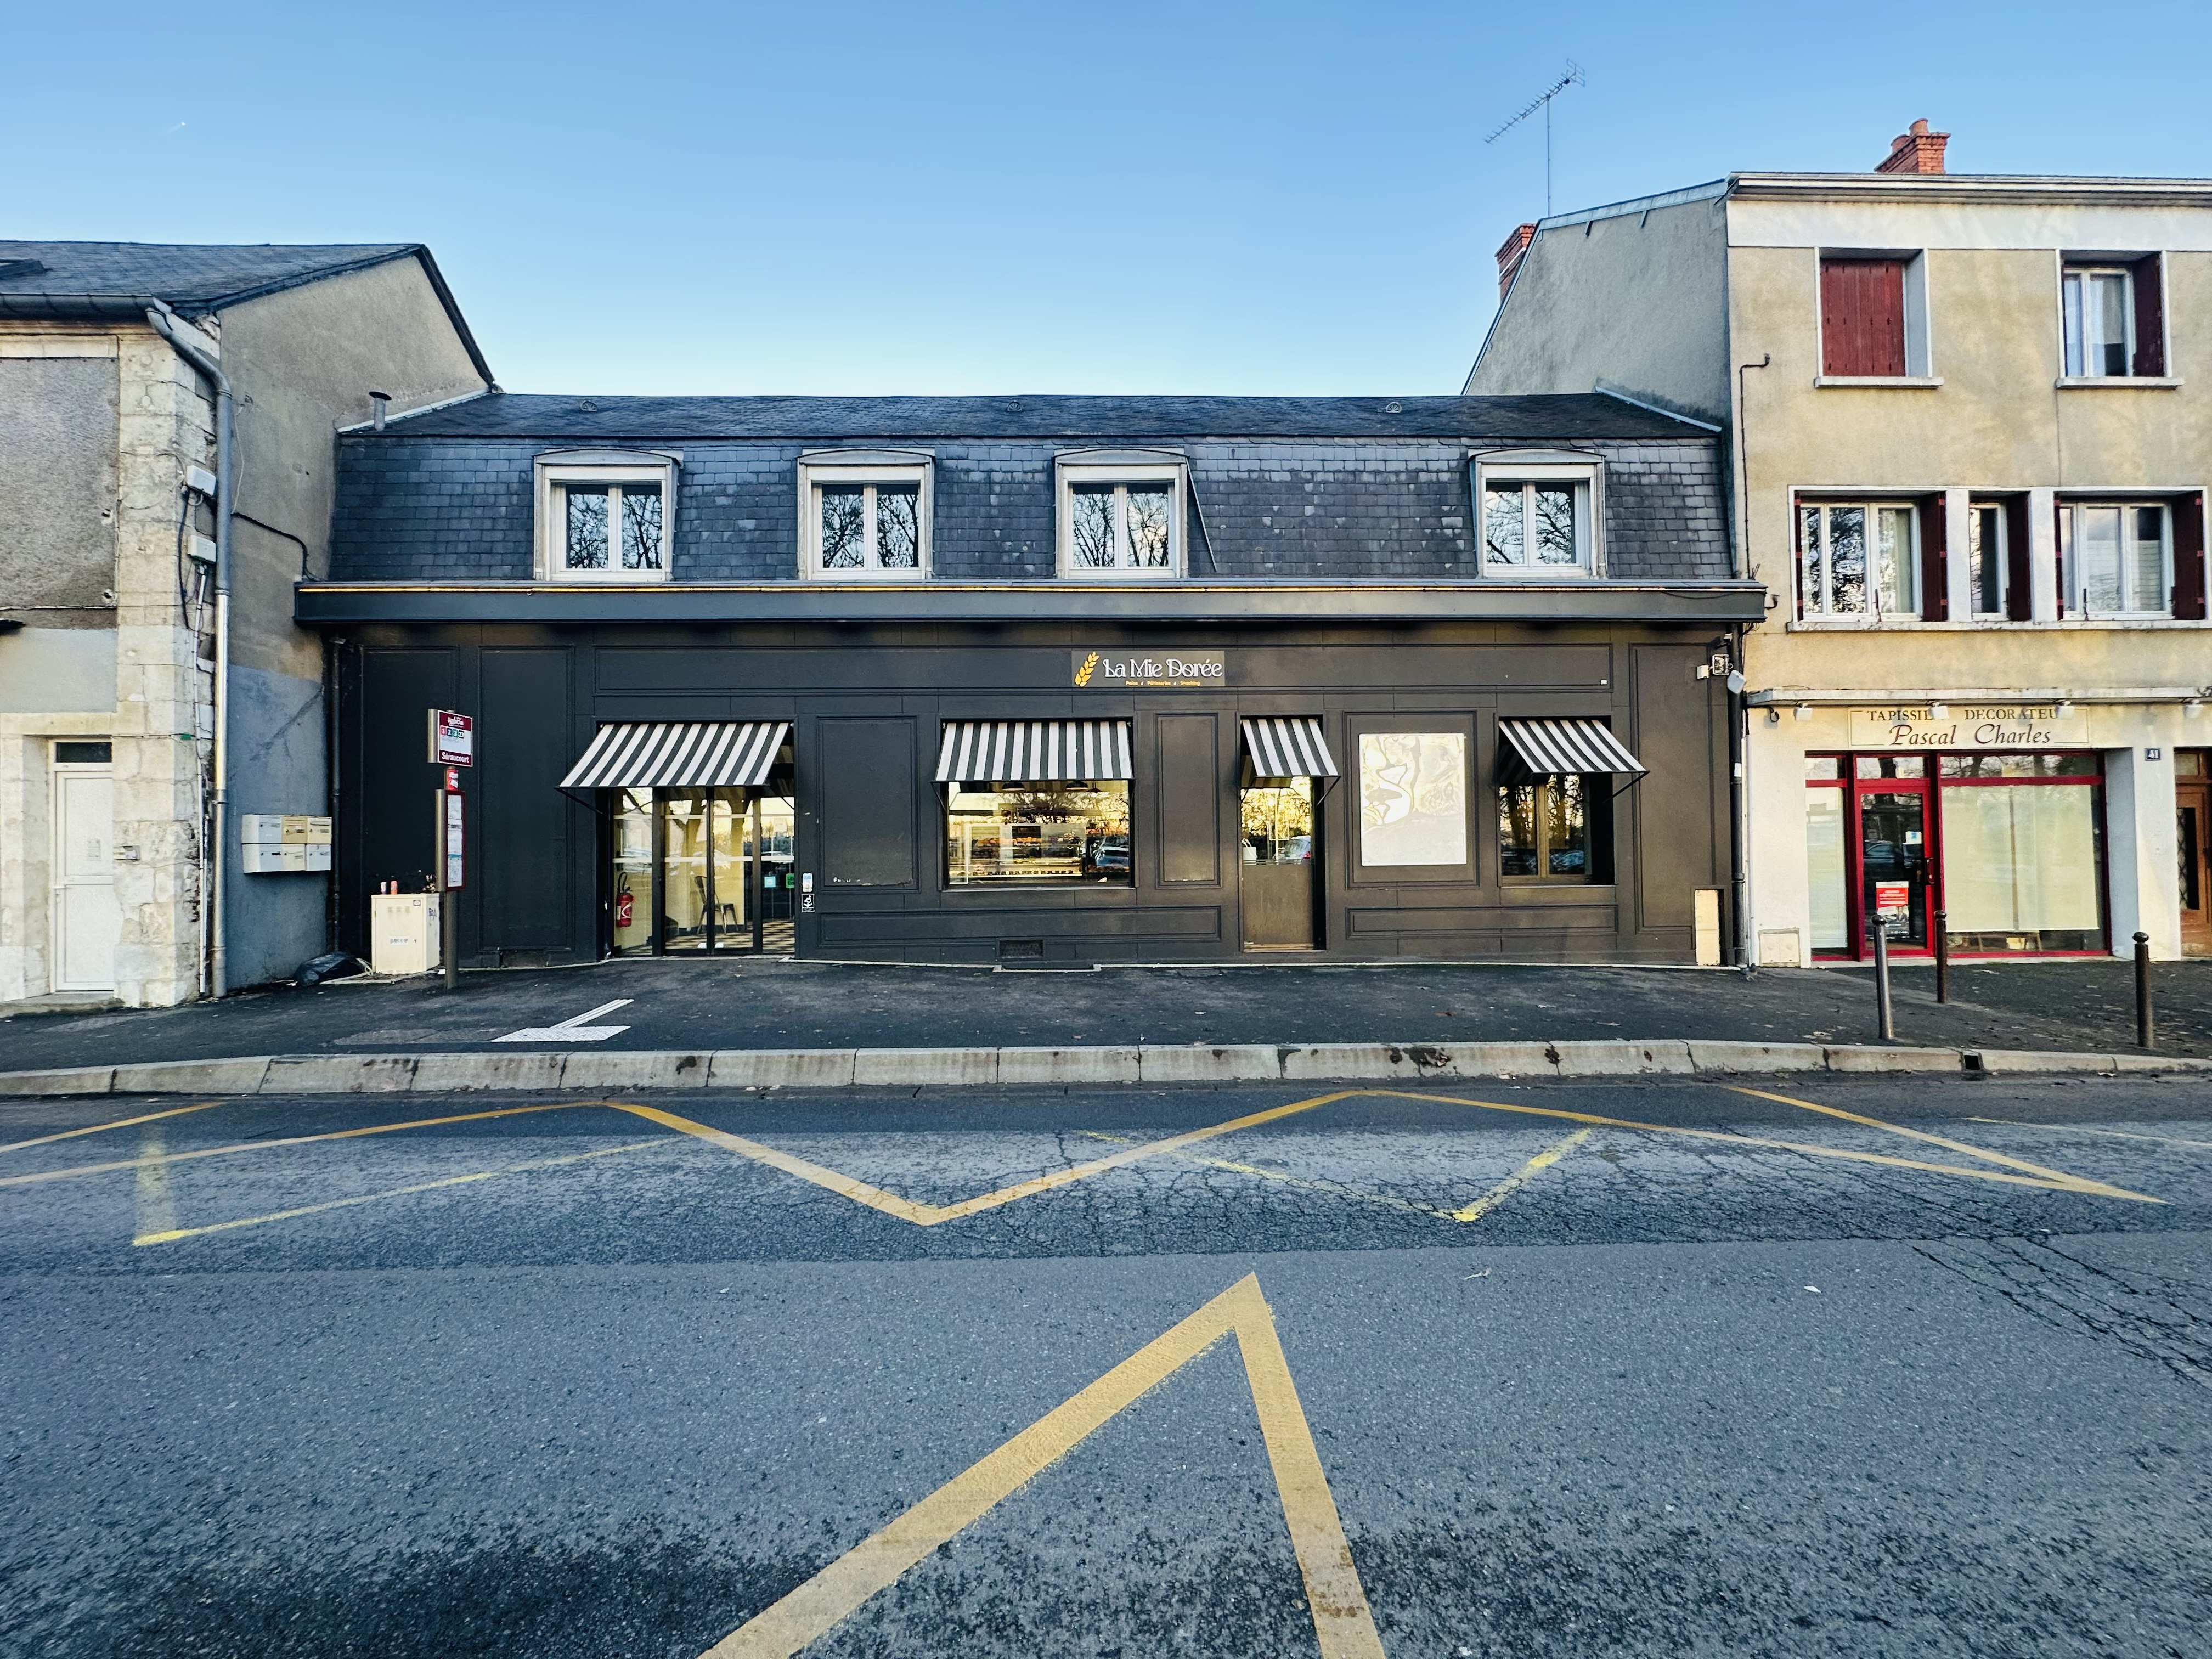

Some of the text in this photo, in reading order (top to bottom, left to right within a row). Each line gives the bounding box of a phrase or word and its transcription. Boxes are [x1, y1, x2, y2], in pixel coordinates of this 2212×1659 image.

[1103, 658, 1223, 678] La Mie Dorée
[1867, 708, 2058, 721] TAPISSIE DECORATEU
[1889, 723, 2051, 746] Pascal Charles
[2148, 749, 2159, 759] 41
